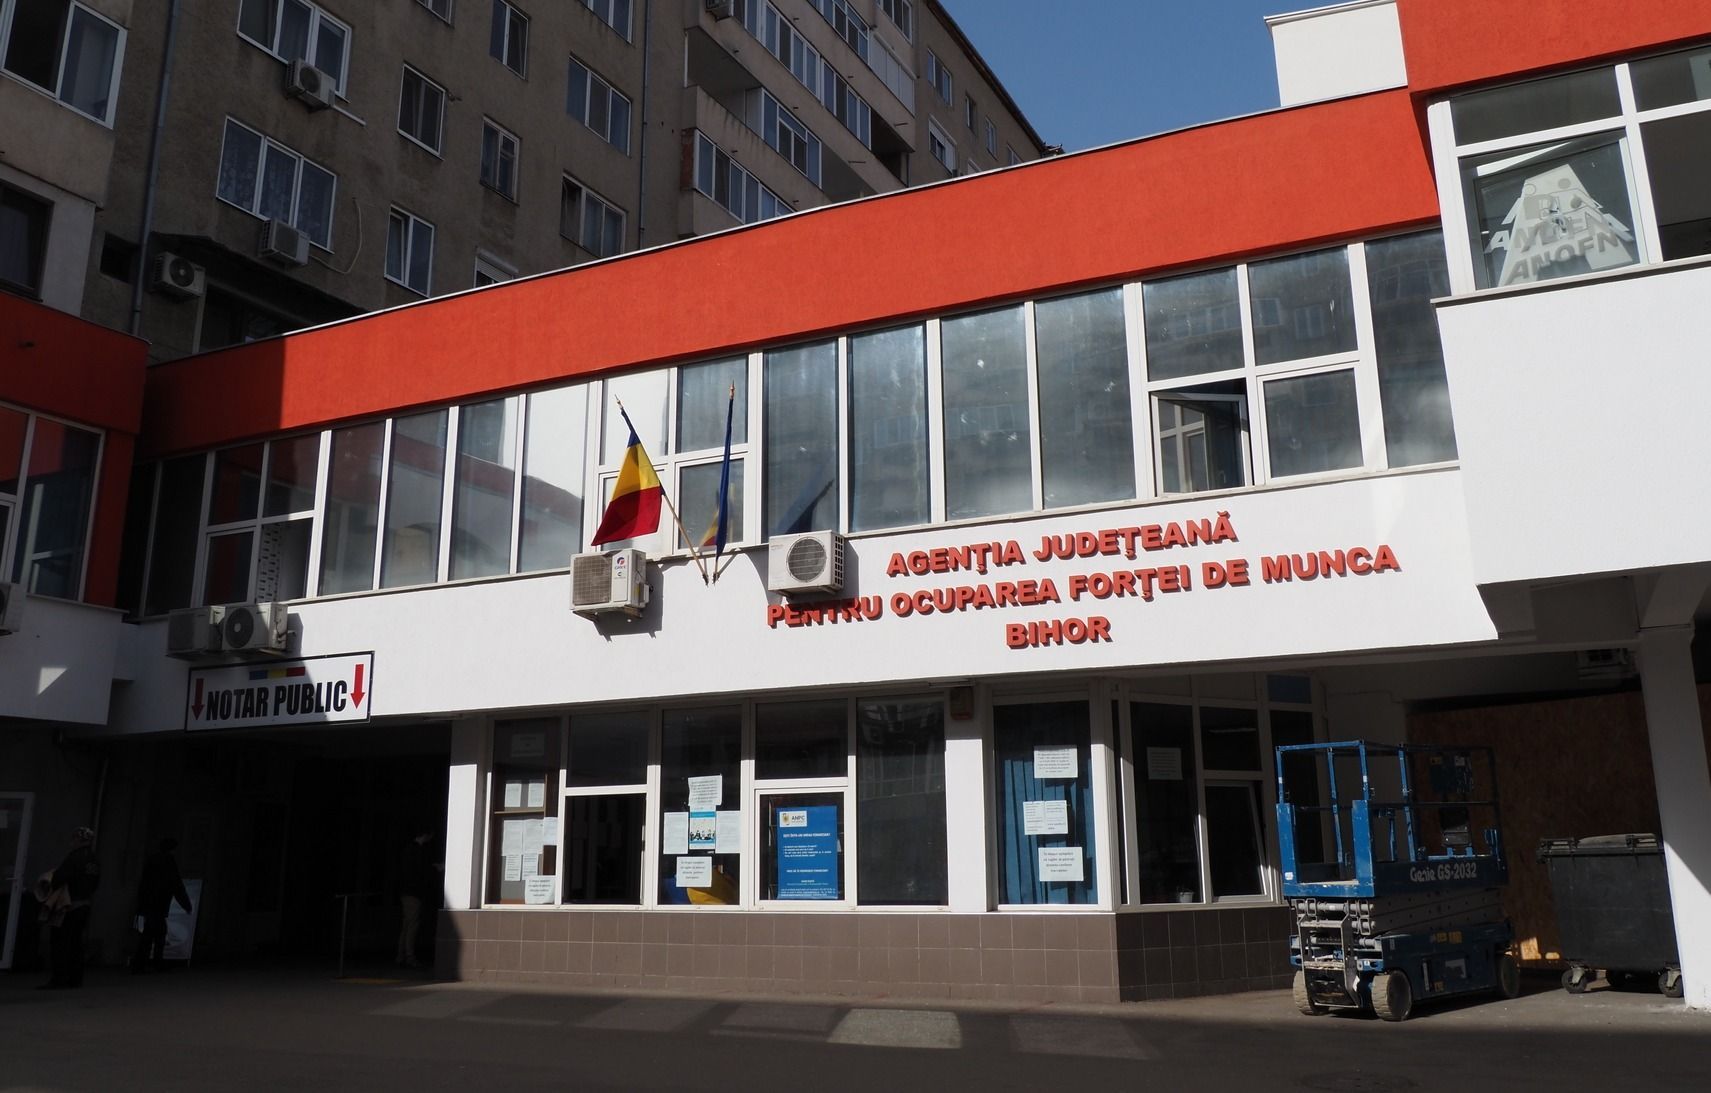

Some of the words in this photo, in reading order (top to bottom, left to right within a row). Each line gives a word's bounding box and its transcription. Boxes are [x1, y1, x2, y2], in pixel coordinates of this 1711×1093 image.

[767, 595, 883, 629] PENTRU
[890, 578, 1060, 617] OCUPAREA
[1202, 559, 1250, 589] DE
[1260, 545, 1401, 583] MUNCA
[1006, 616, 1112, 650] BIHOR
[206, 686, 269, 721] NOTAR
[273, 680, 347, 716] PUBLIC
[1410, 867, 1436, 883] Genie
[1438, 864, 1476, 880] GS-2032
